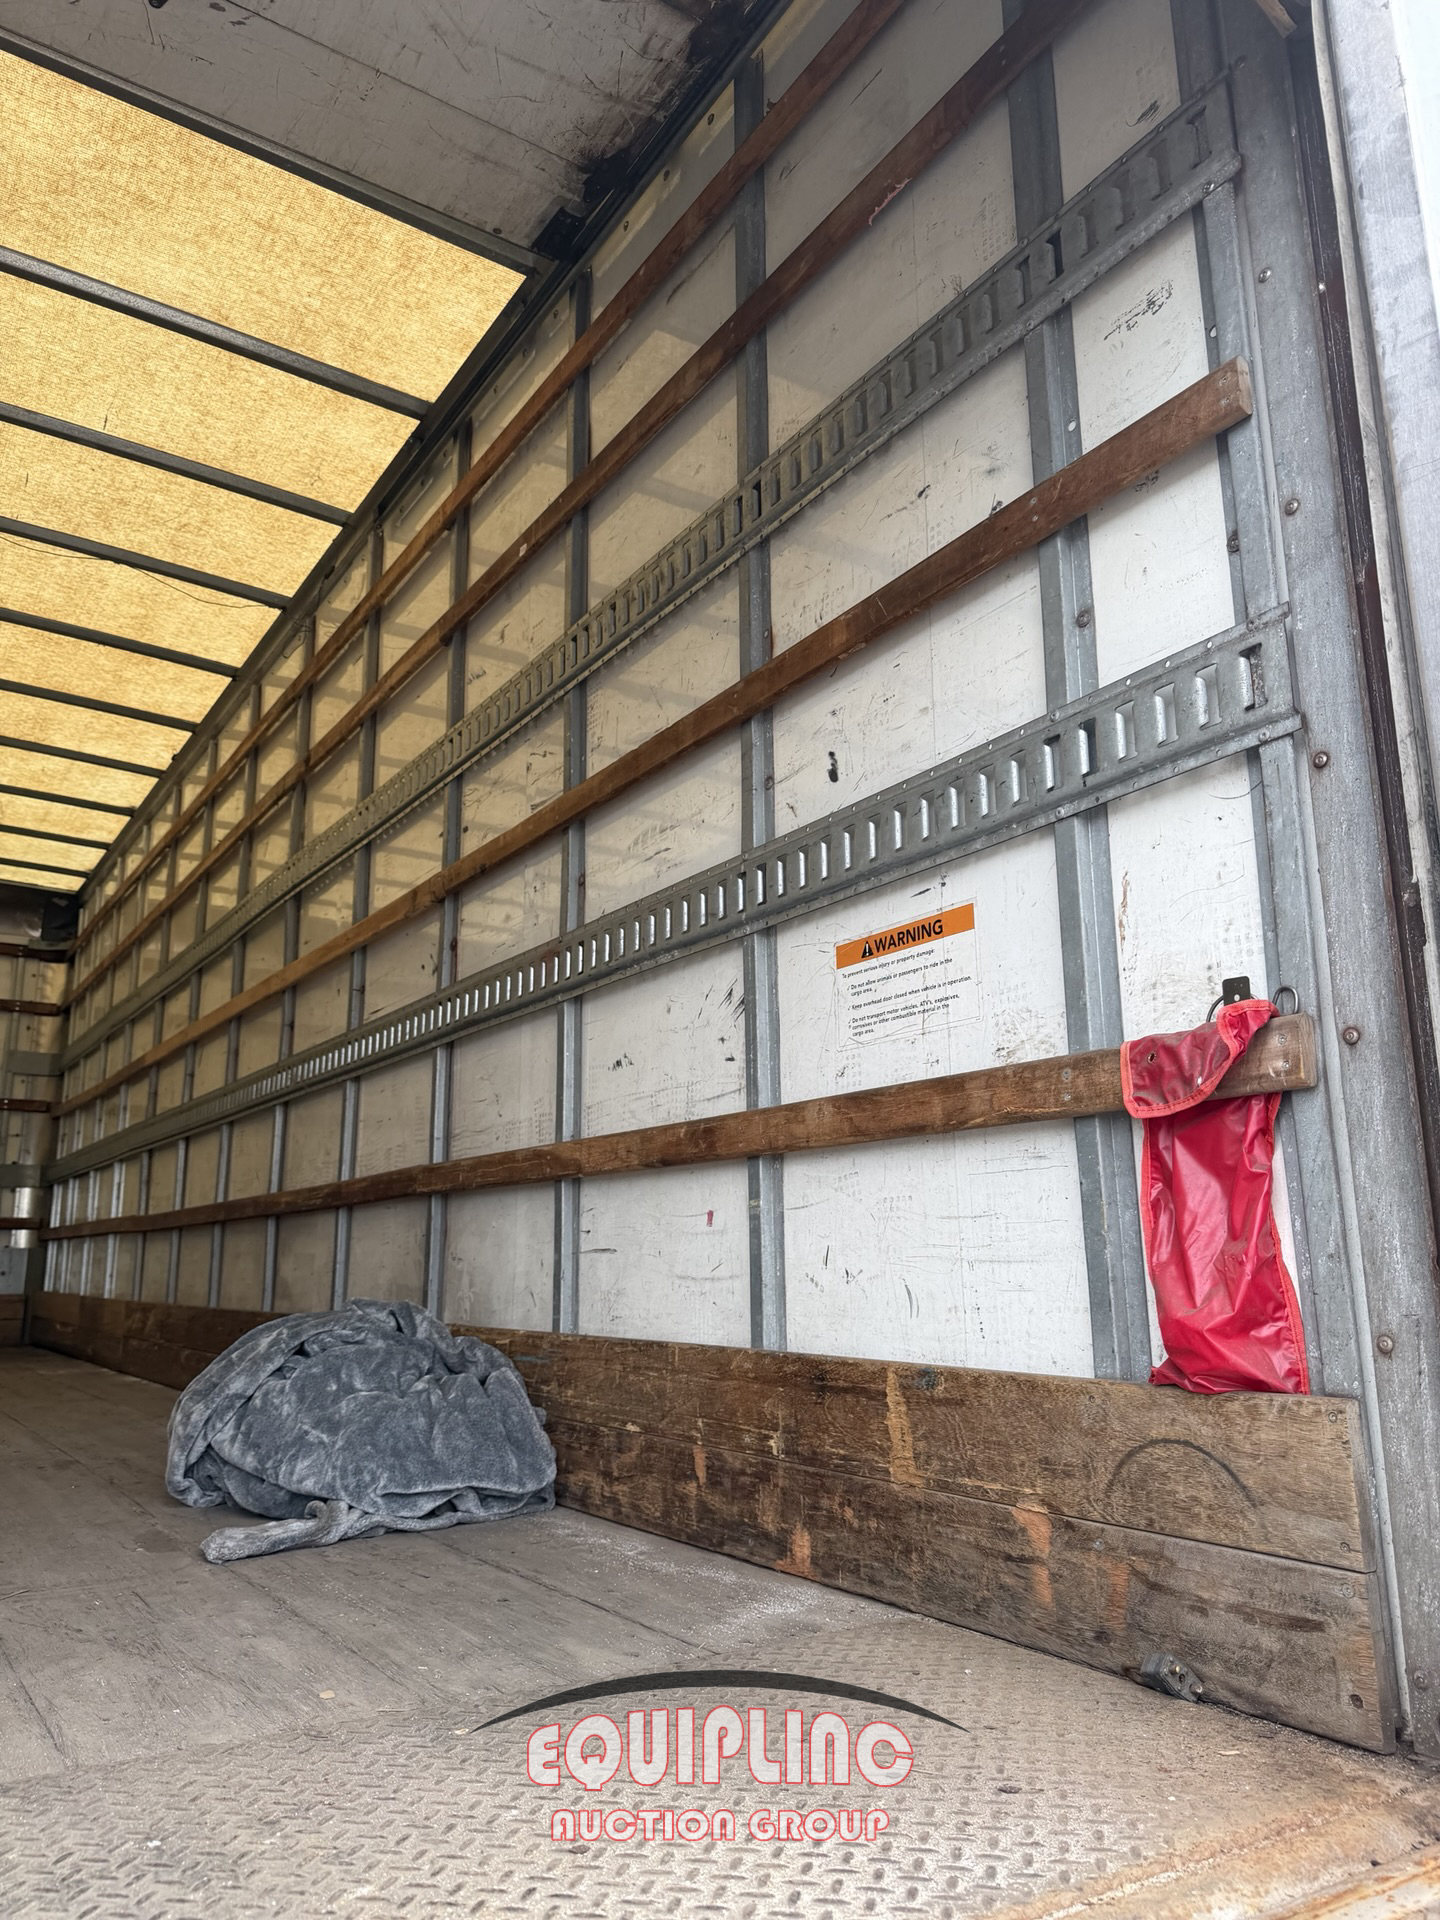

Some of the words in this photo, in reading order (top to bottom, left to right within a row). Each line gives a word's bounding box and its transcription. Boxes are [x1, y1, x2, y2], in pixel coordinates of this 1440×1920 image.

[874, 919, 943, 953] WARNING
[848, 969, 863, 978] prevent
[897, 954, 915, 964] property
[877, 974, 892, 982] animals
[899, 966, 922, 978] passengers
[863, 998, 882, 1006] overhead
[894, 991, 907, 999] closed
[921, 984, 936, 992] vehicle
[947, 976, 972, 986] operation.
[852, 1022, 872, 1030] corrosives
[890, 1010, 916, 1021] combustible
[918, 1004, 935, 1014] material
[867, 1011, 886, 1020] transport
